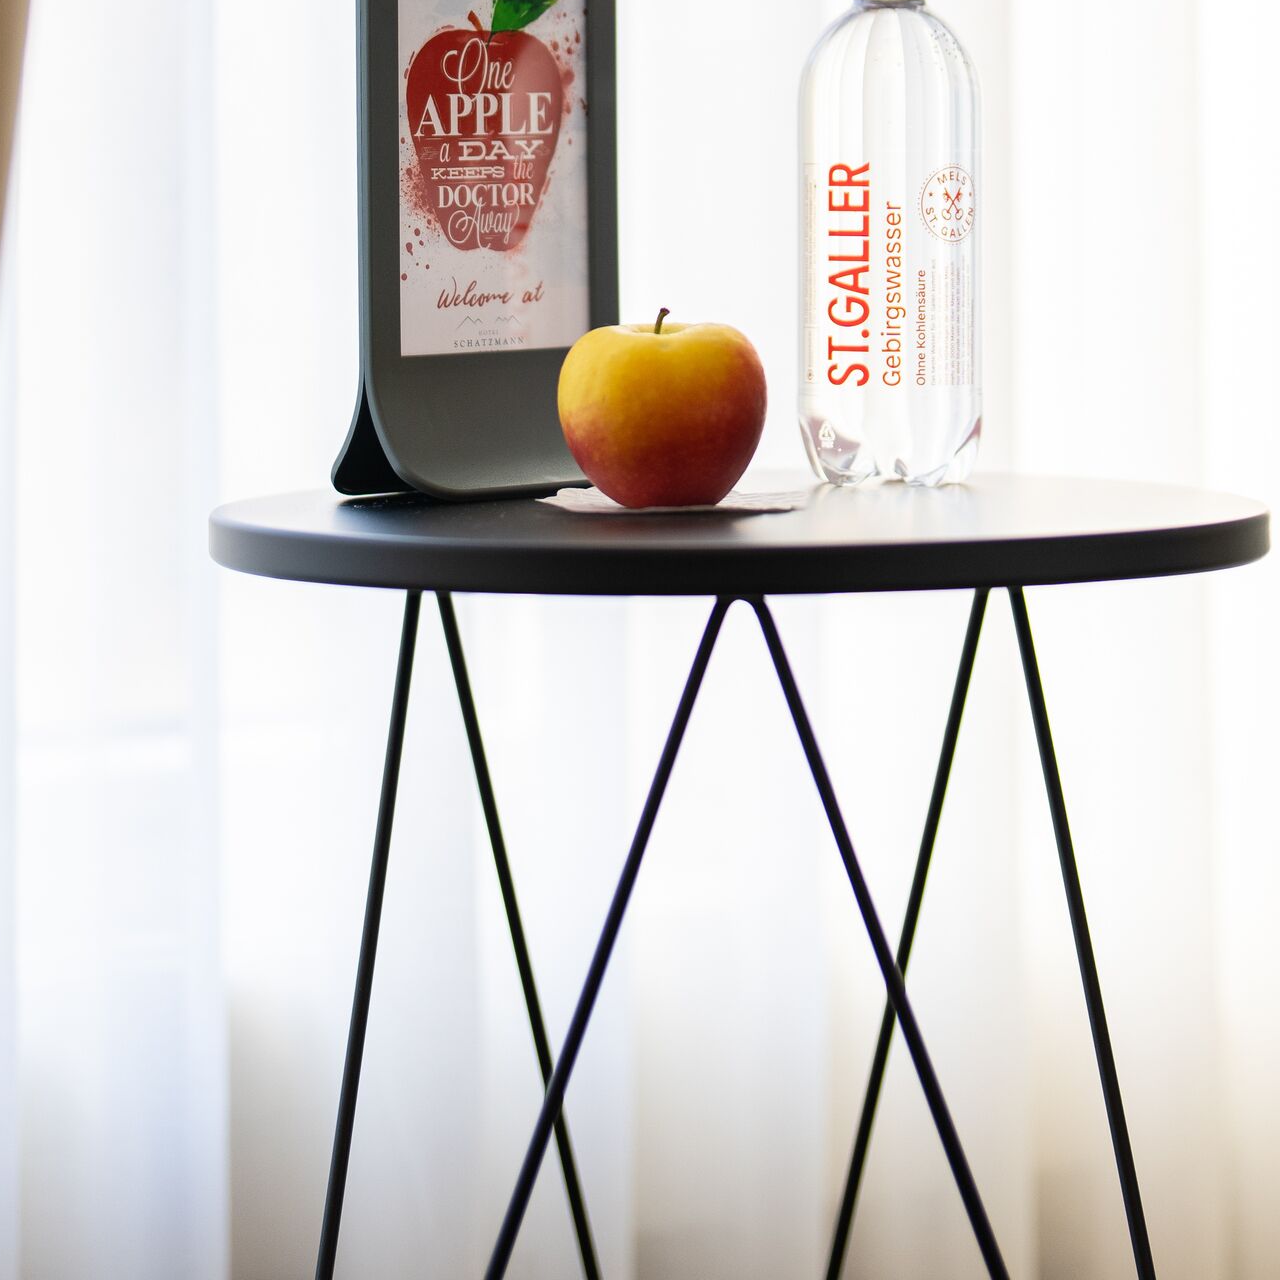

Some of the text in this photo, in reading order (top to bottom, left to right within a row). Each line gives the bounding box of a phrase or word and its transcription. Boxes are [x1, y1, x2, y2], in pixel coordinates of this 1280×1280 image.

[443, 37, 515, 102] One
[414, 92, 554, 137] APPLE
[431, 153, 535, 180] KEEPS the
[439, 139, 545, 162] a DAY
[937, 170, 967, 186] MELS
[438, 183, 536, 208] DOCTOR
[448, 197, 520, 249] Away
[940, 207, 975, 239] GALLEN
[827, 162, 870, 387] ST.GALLER
[437, 276, 545, 309] Welcome at
[880, 201, 906, 386] Gebirgswasser
[453, 336, 526, 349] SCHATZMANN
[916, 269, 927, 386] Ohne Kohlensäure
